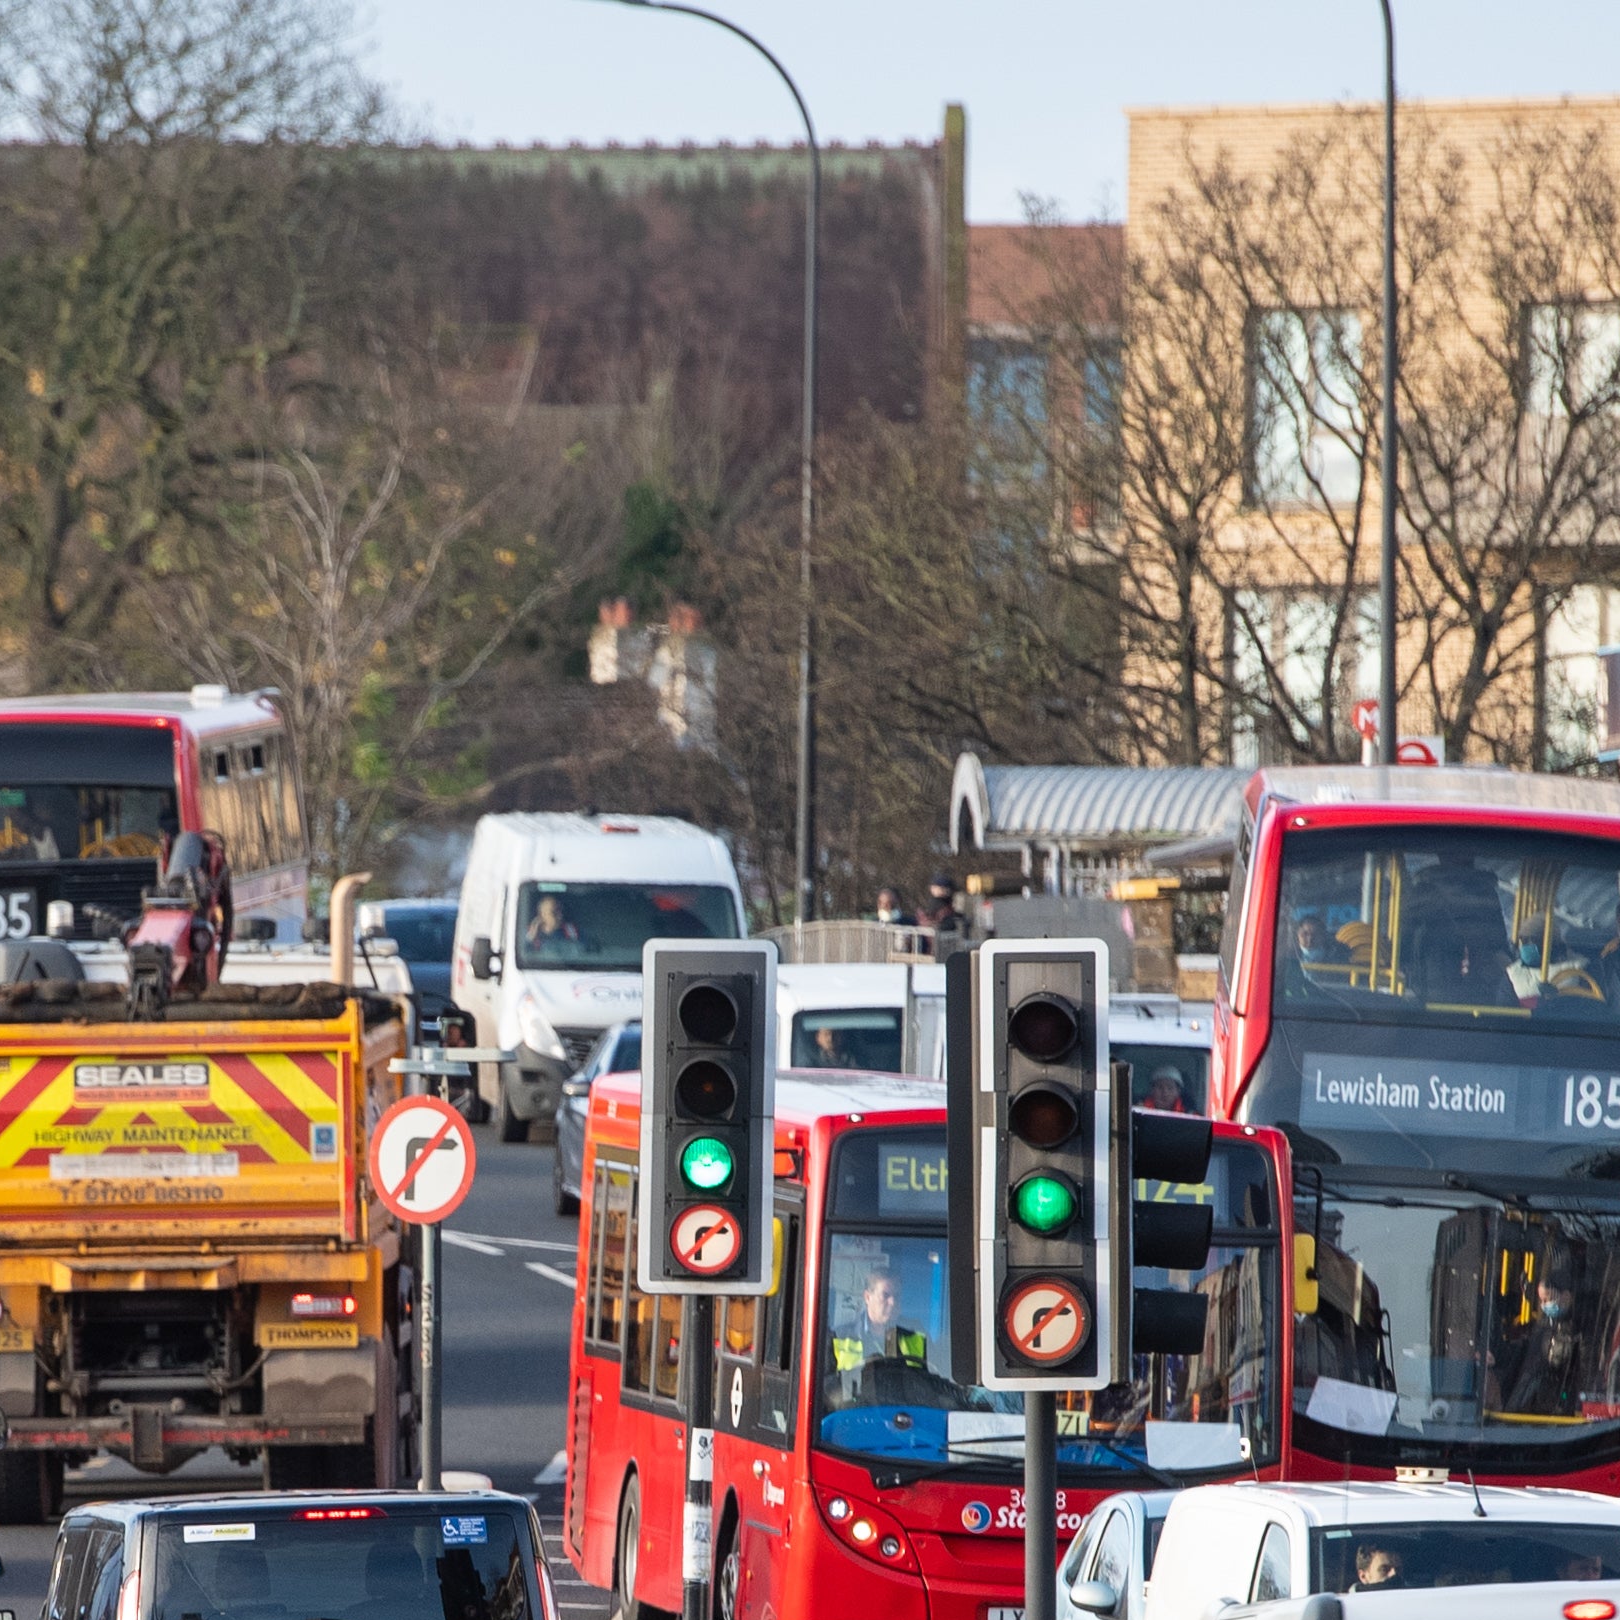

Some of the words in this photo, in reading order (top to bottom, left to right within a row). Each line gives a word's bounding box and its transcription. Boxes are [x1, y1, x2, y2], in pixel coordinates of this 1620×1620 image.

[74, 1064, 208, 1087] SEALES
[1315, 1069, 1420, 1111] Lewisham
[1428, 1078, 1507, 1116] Station
[34, 1128, 116, 1145] HIGHWAY
[122, 1125, 254, 1143] MAINTENANCE
[85, 1186, 146, 1203] 01708
[267, 1328, 353, 1342] THOMPSONS
